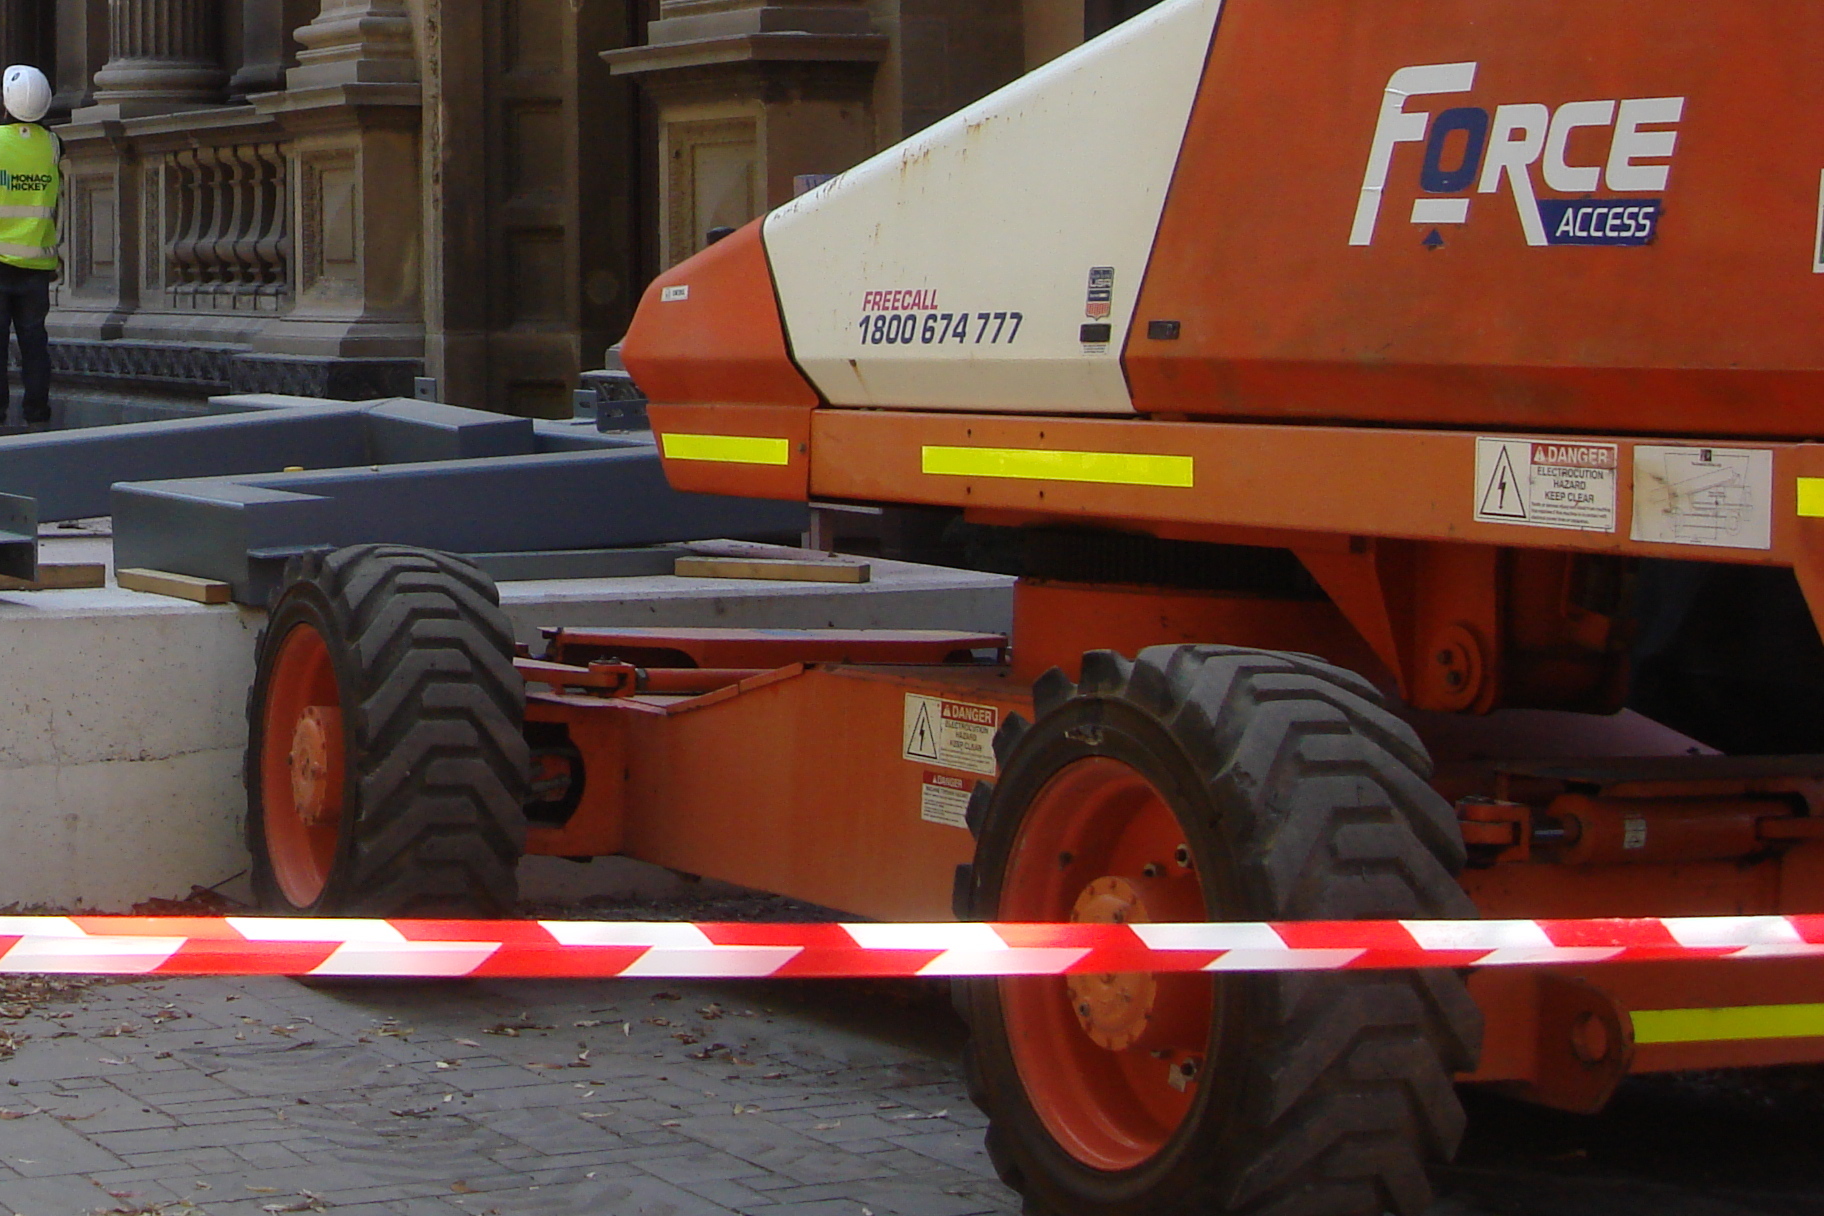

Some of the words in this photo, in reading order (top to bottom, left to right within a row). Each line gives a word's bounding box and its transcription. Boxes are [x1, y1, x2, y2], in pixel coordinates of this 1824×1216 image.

[1349, 62, 1684, 245] FORCE
[11, 174, 53, 183] MONACO
[11, 183, 47, 191] HICKEY
[1555, 207, 1655, 237] ACCESS
[862, 289, 939, 312] FREECALL
[858, 313, 917, 345] 1800
[921, 313, 969, 344] 674
[974, 312, 1023, 344] 777
[1548, 446, 1608, 465] DANGER
[1537, 466, 1604, 480] ELECTROCUTION
[1553, 480, 1586, 490] HAZARD
[1545, 491, 1566, 501] KEEP
[1567, 493, 1594, 503] CLEAR
[952, 705, 992, 723] DANGER
